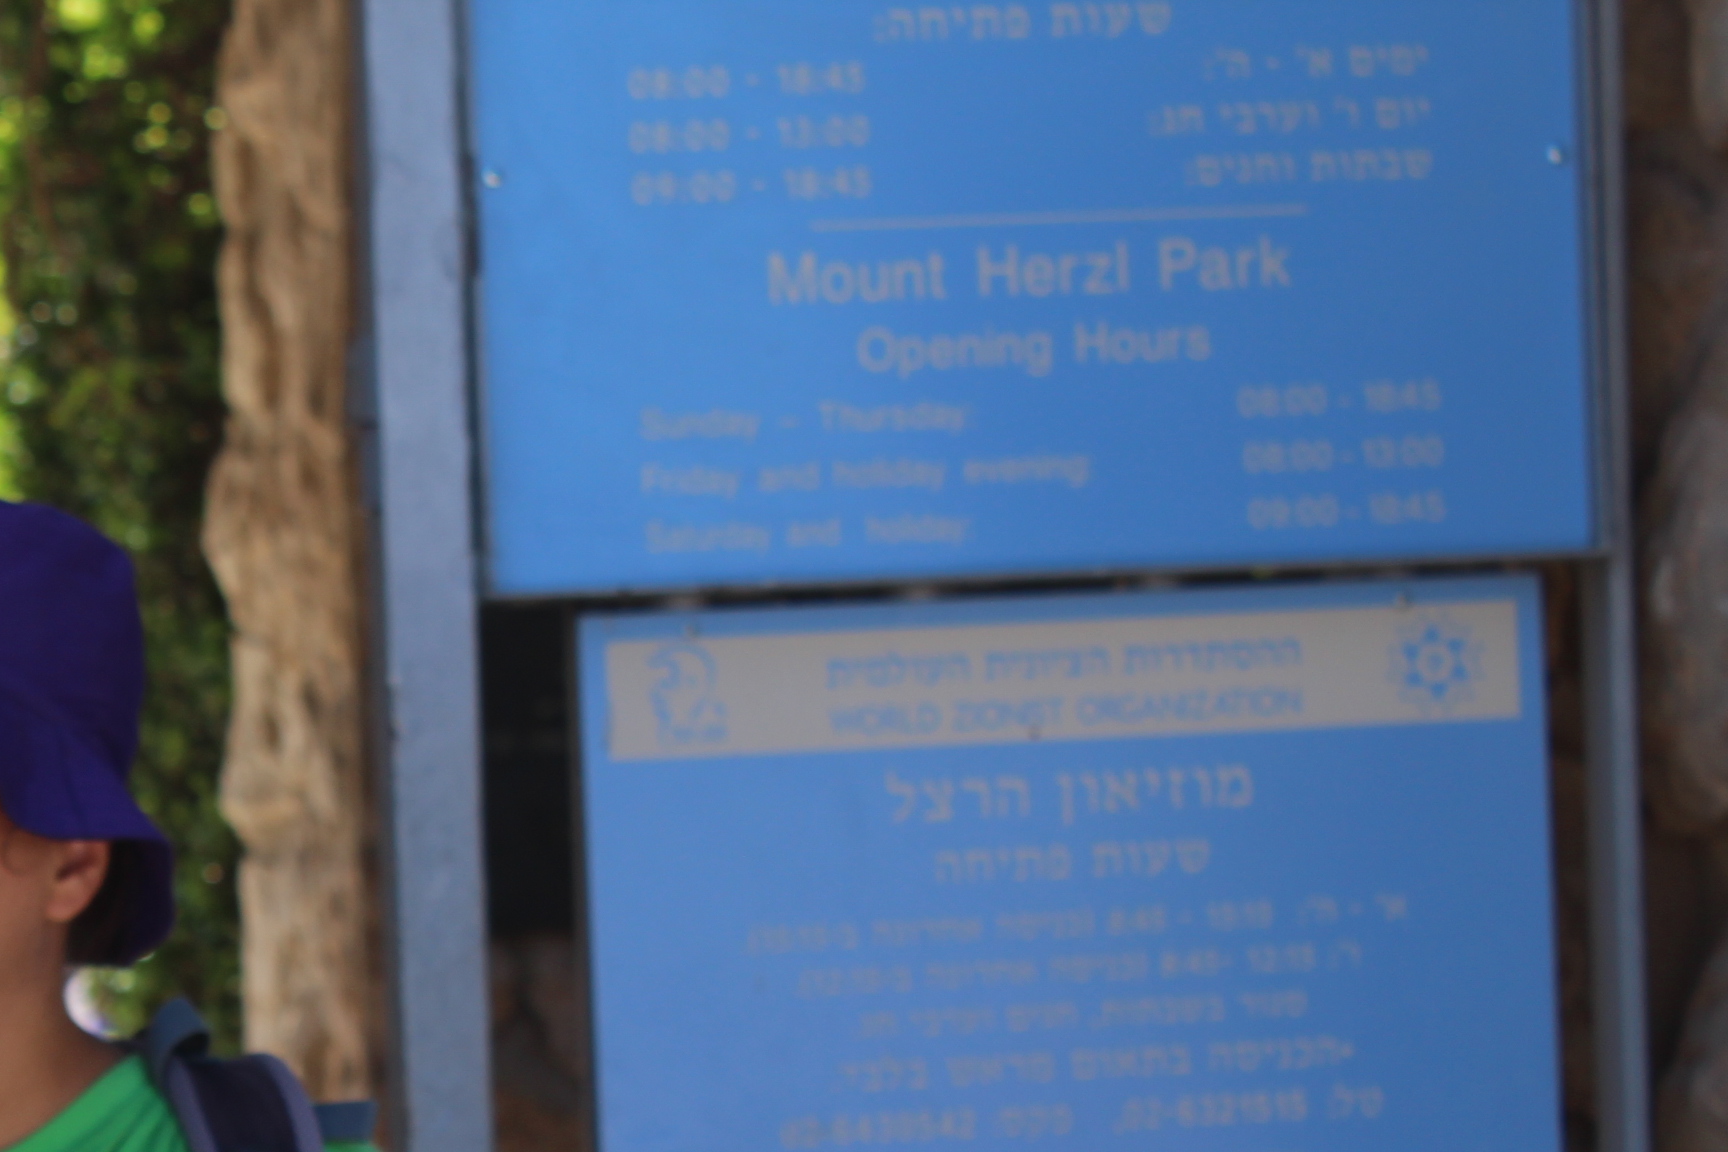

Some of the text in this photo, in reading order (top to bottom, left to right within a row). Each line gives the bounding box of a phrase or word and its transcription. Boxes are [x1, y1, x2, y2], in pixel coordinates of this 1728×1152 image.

[1049, 1, 1172, 38] שעות
[1347, 42, 1430, 77] ימים
[1374, 97, 1432, 130] יום
[1310, 148, 1433, 181] שבתות
[766, 234, 1293, 305] Mount Herzl Park
[856, 321, 1213, 378] Opening Hours
[638, 405, 762, 444] Sunday
[639, 461, 740, 499] Friday
[757, 462, 821, 491] and
[831, 455, 946, 491] holiday
[644, 518, 770, 556] Saturday
[785, 519, 842, 547] and
[829, 689, 1304, 734] WORLD ZIONIST ORGANIZATION
[884, 764, 1256, 826] מוזיאון הרצל
[933, 838, 1212, 884] שעות פתיחה
